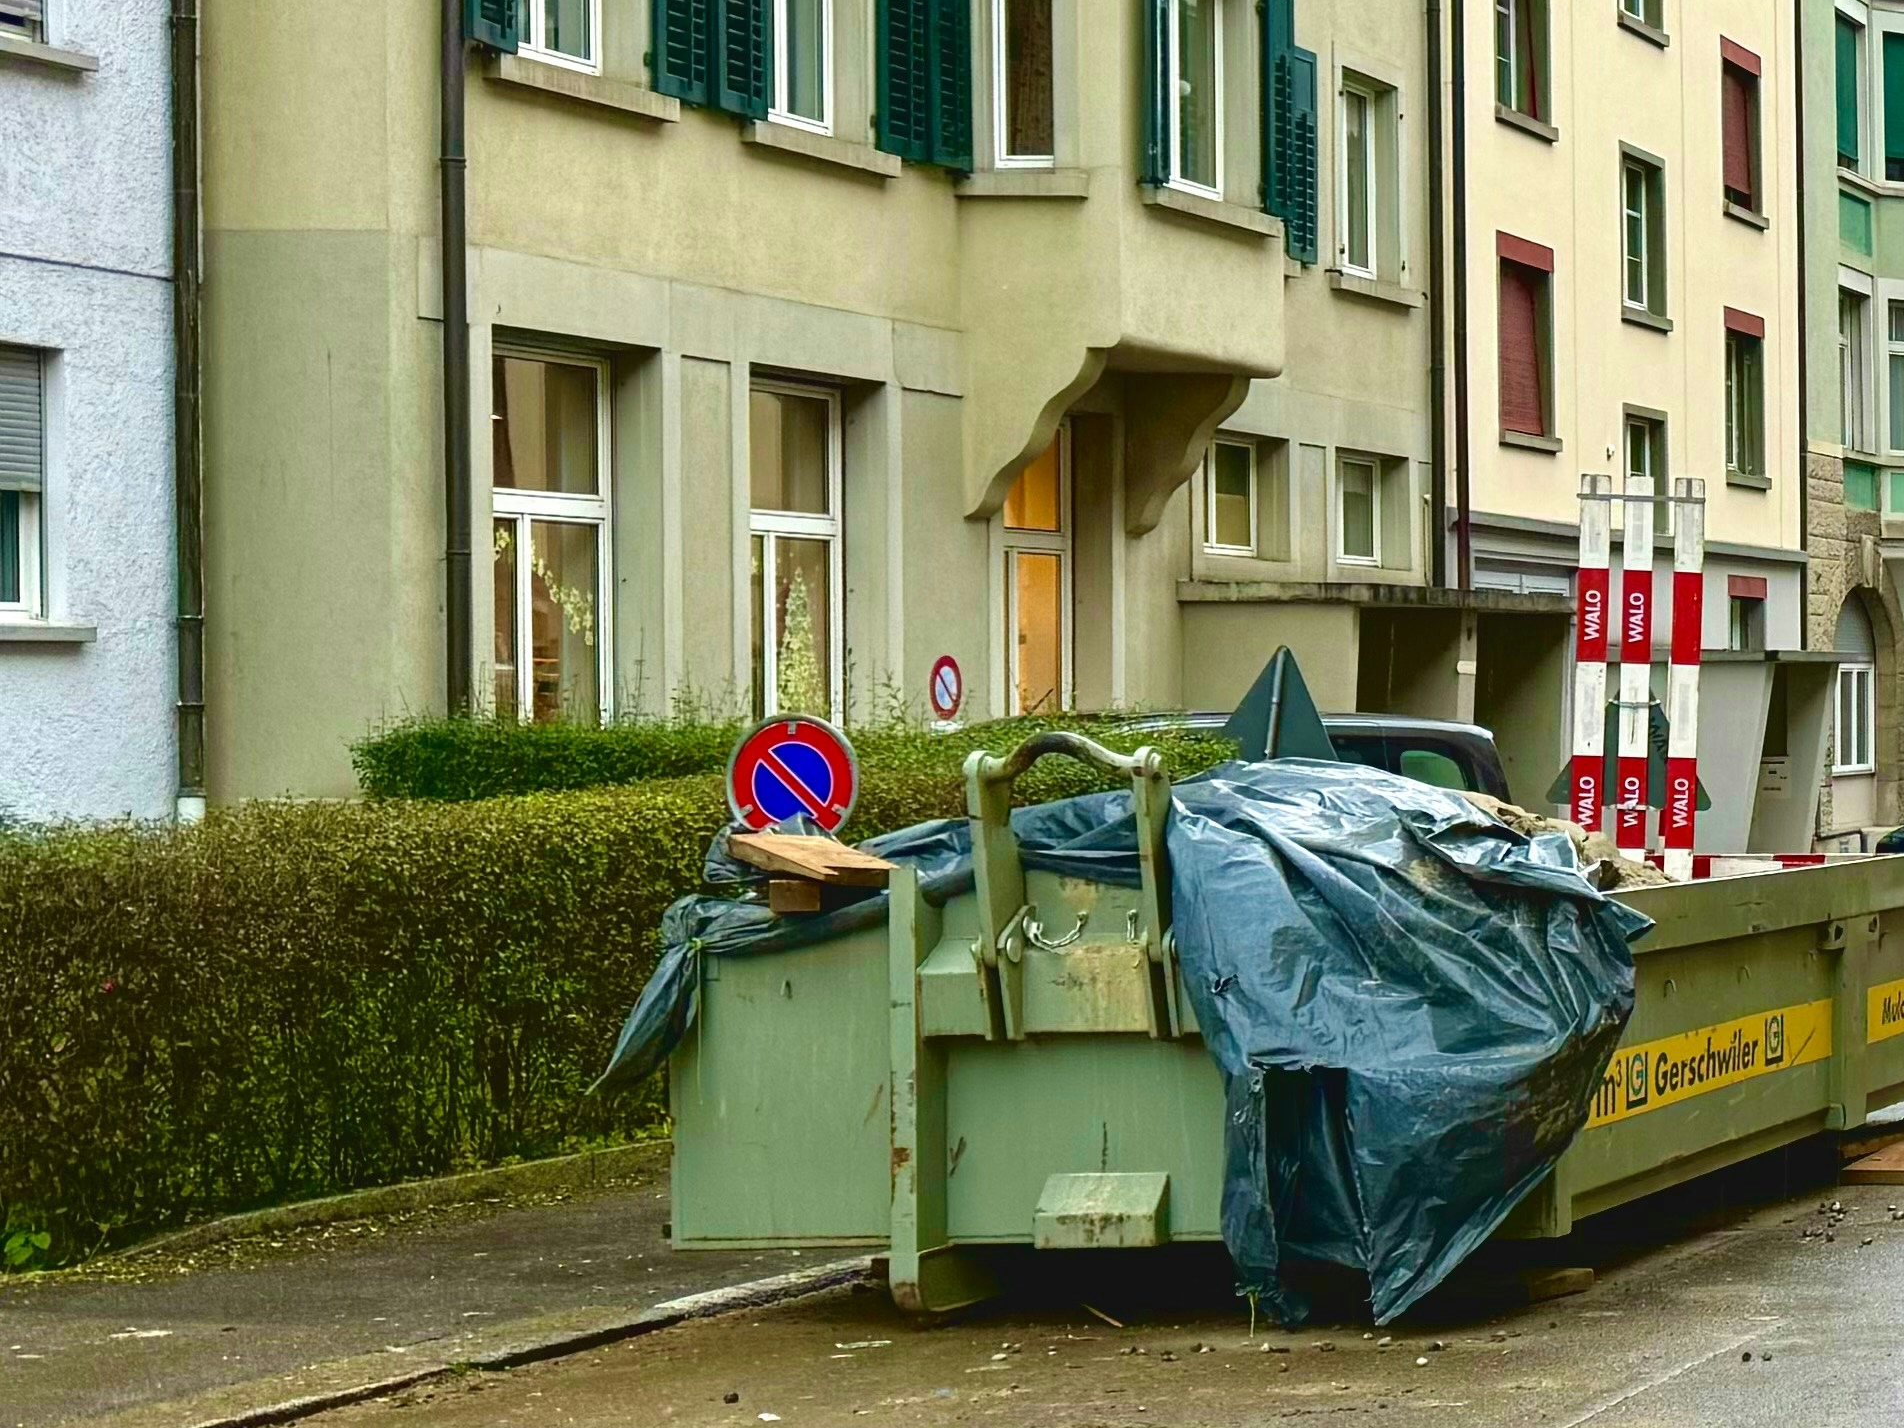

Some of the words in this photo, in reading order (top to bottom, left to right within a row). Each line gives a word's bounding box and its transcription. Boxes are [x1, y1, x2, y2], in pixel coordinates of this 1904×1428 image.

[1583, 589, 1601, 641] WALO
[1628, 592, 1644, 643] WALO
[1578, 776, 1595, 827] WALO
[1623, 776, 1640, 828] WALO
[1672, 777, 1688, 828] WALO
[1655, 1029, 1758, 1097] Gerschwiler
